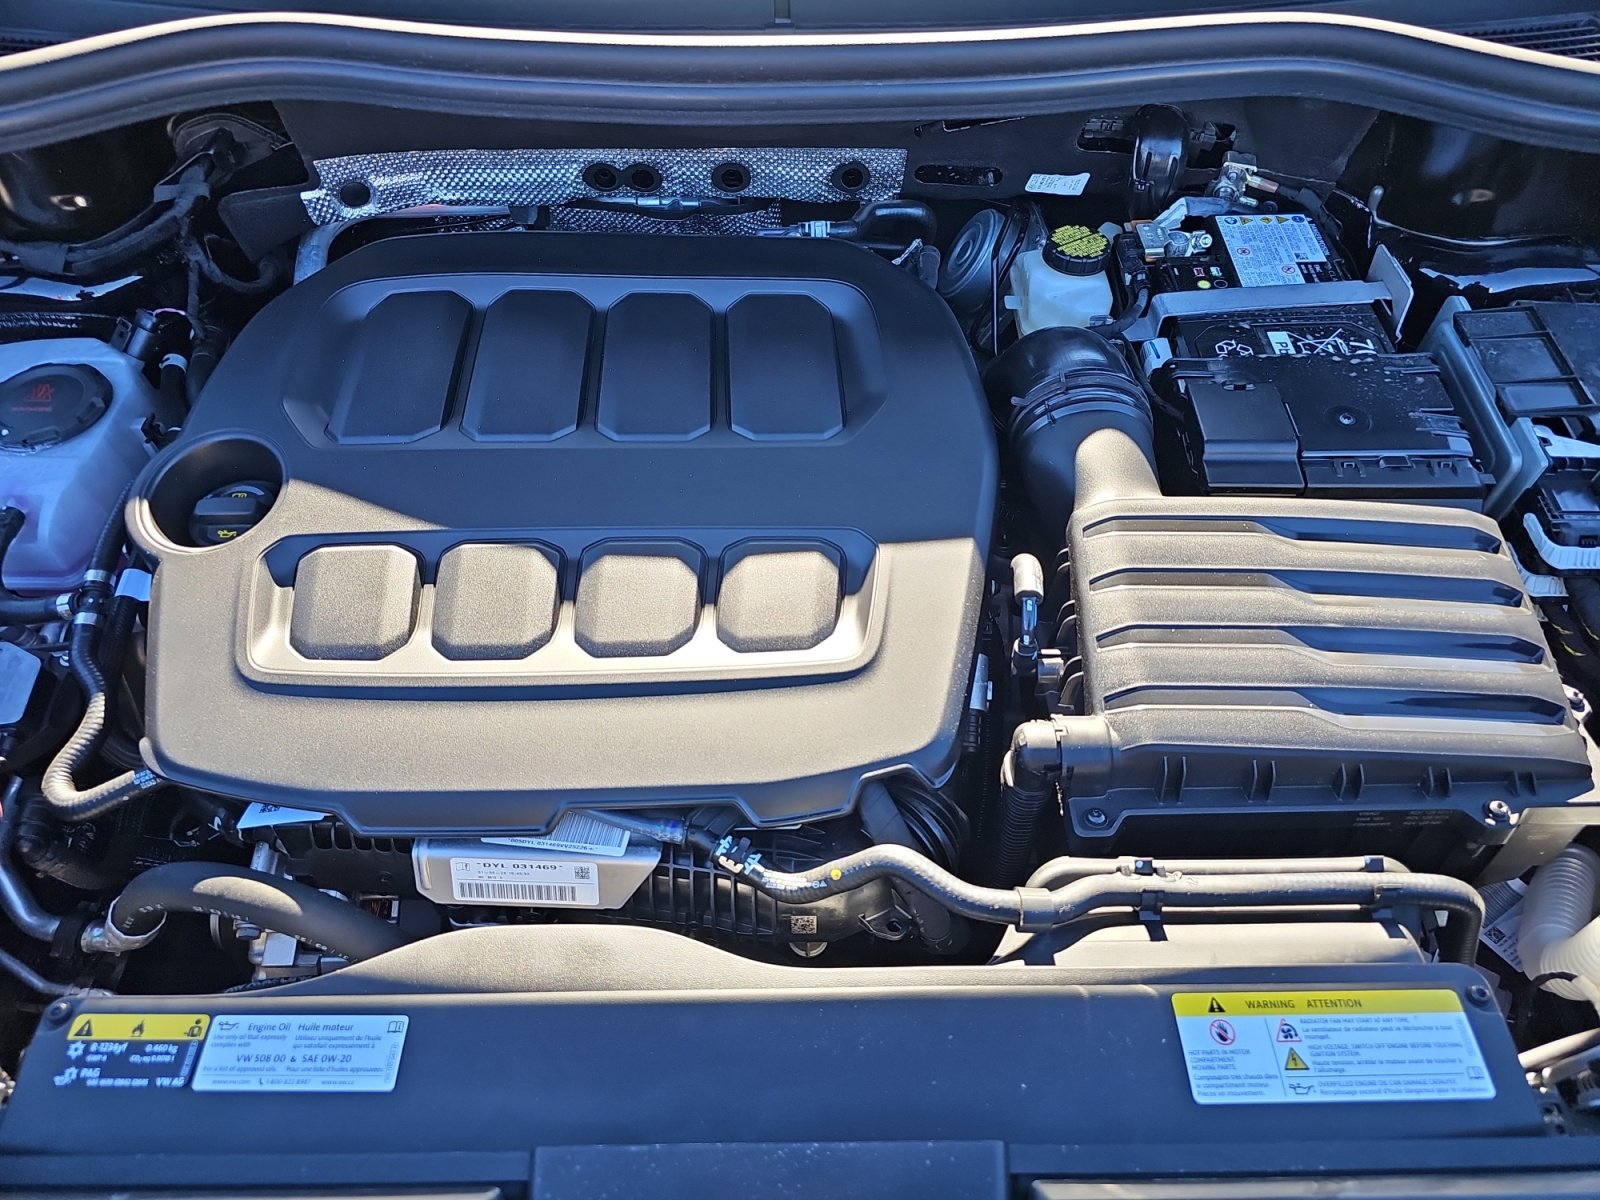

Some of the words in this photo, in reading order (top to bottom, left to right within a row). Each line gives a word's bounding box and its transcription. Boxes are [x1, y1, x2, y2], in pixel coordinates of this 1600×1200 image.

[1245, 999, 1295, 1009] WARNING
[1307, 998, 1362, 1008] ATTENTION
[247, 1022, 276, 1032] Engine
[278, 1022, 292, 1031] Oil
[298, 1022, 321, 1031] Huile
[322, 1023, 354, 1031] moteur
[237, 1054, 254, 1062] VW
[254, 1054, 272, 1062] 508
[273, 1054, 286, 1062] 00
[290, 1055, 297, 1063] &
[302, 1054, 319, 1063] SAE
[321, 1054, 352, 1063] 0W-20
